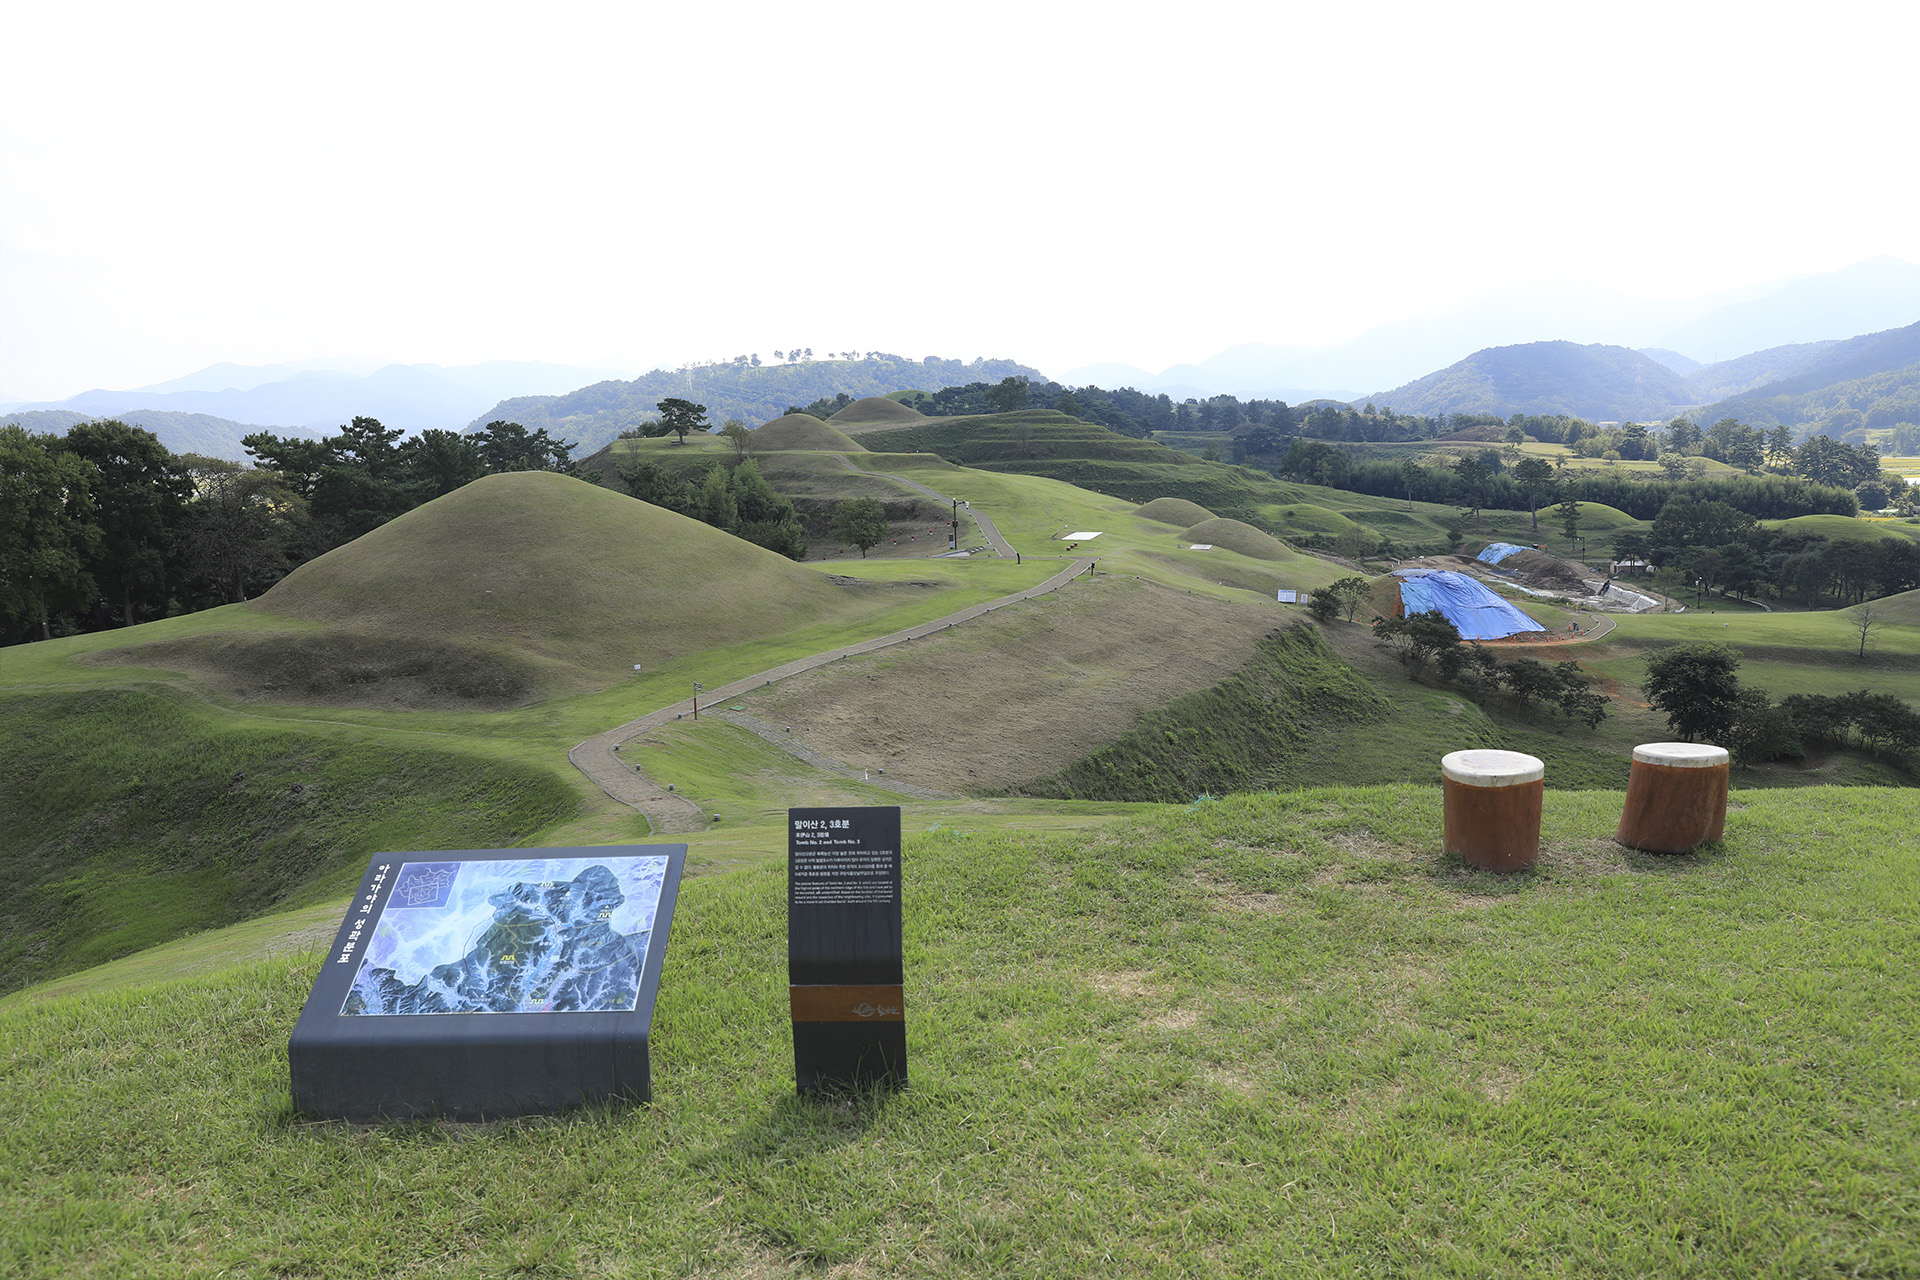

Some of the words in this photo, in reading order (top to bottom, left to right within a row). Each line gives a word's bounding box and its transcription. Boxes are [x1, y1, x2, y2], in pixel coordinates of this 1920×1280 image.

[794, 820, 818, 830] 말이산
[820, 820, 827, 830] 2,
[829, 820, 850, 828] 3호분
[360, 864, 390, 914] 아라가야의
